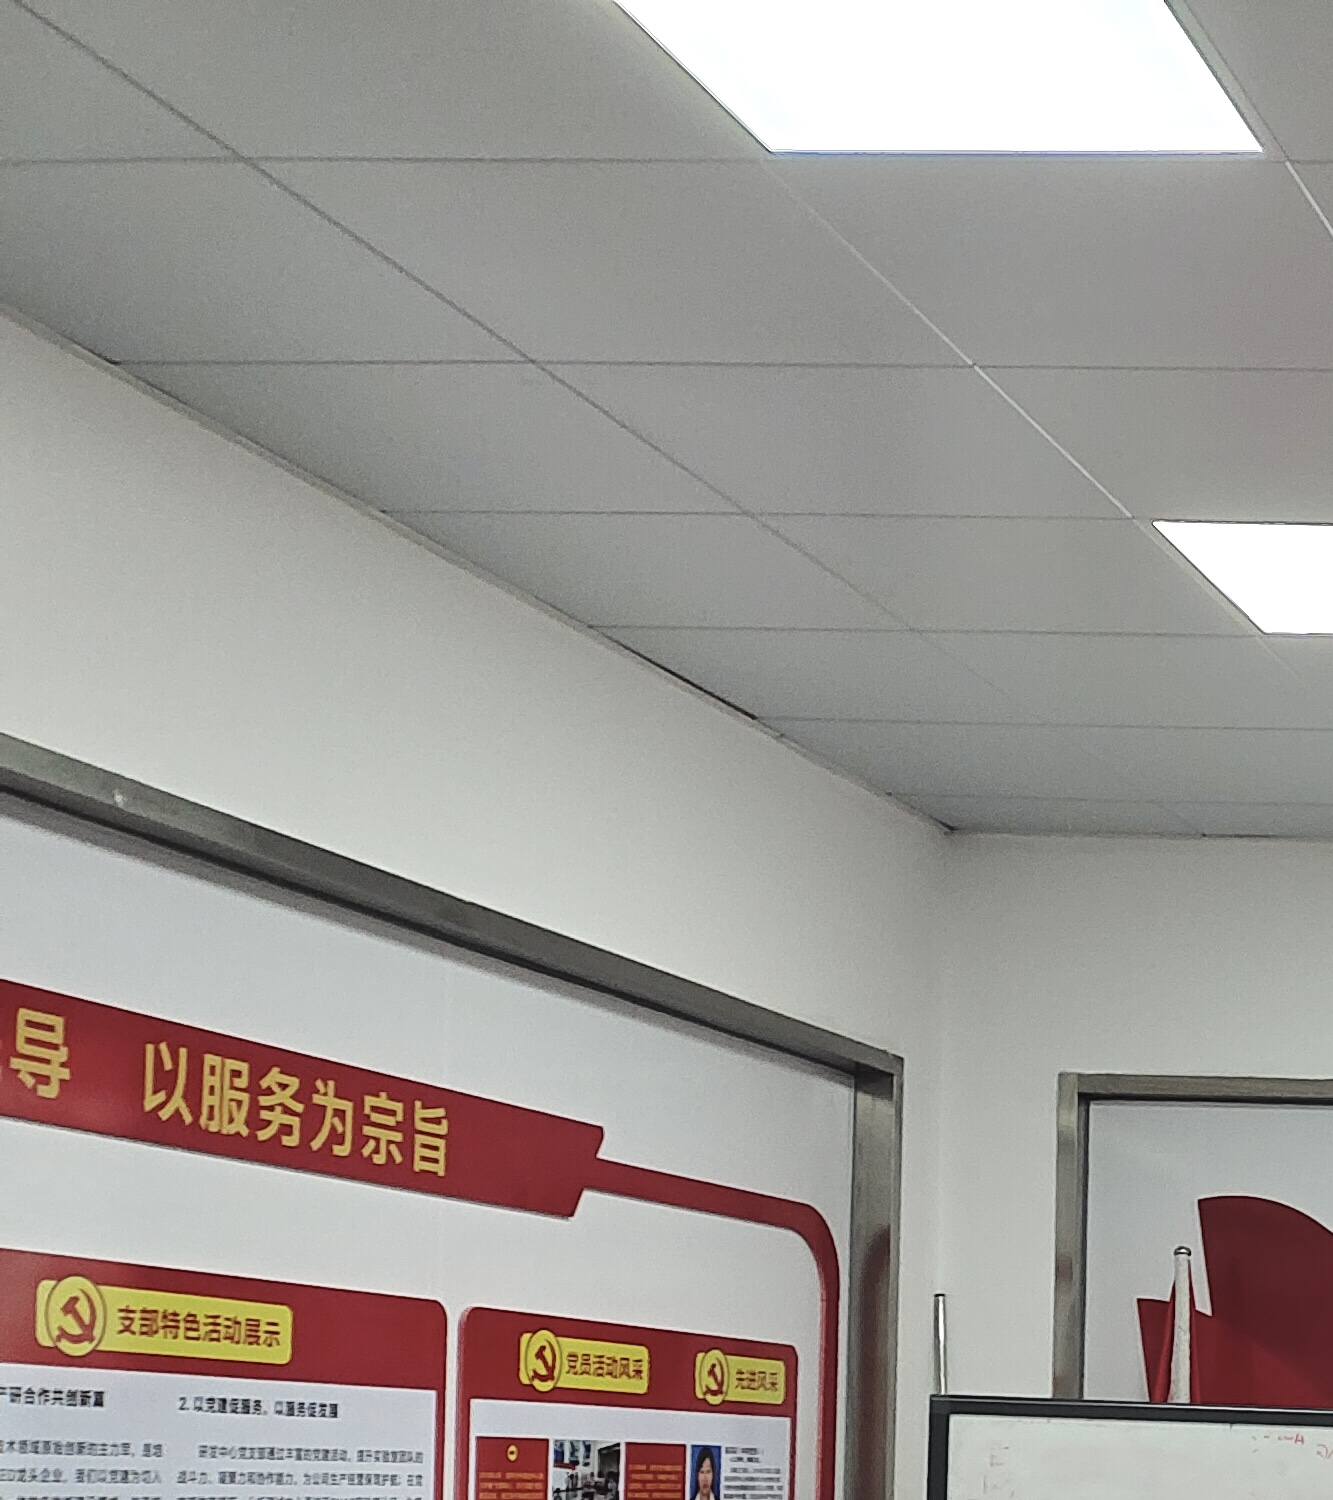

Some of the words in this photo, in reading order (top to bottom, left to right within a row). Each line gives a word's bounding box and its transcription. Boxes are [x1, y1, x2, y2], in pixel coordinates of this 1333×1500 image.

[10, 1008, 70, 1099] 导
[143, 1041, 449, 1177] 以服务为宗旨
[116, 1306, 281, 1348] 支部特色活动展示
[565, 1351, 645, 1382] 党员活动风采
[735, 1368, 779, 1393] 先进风采
